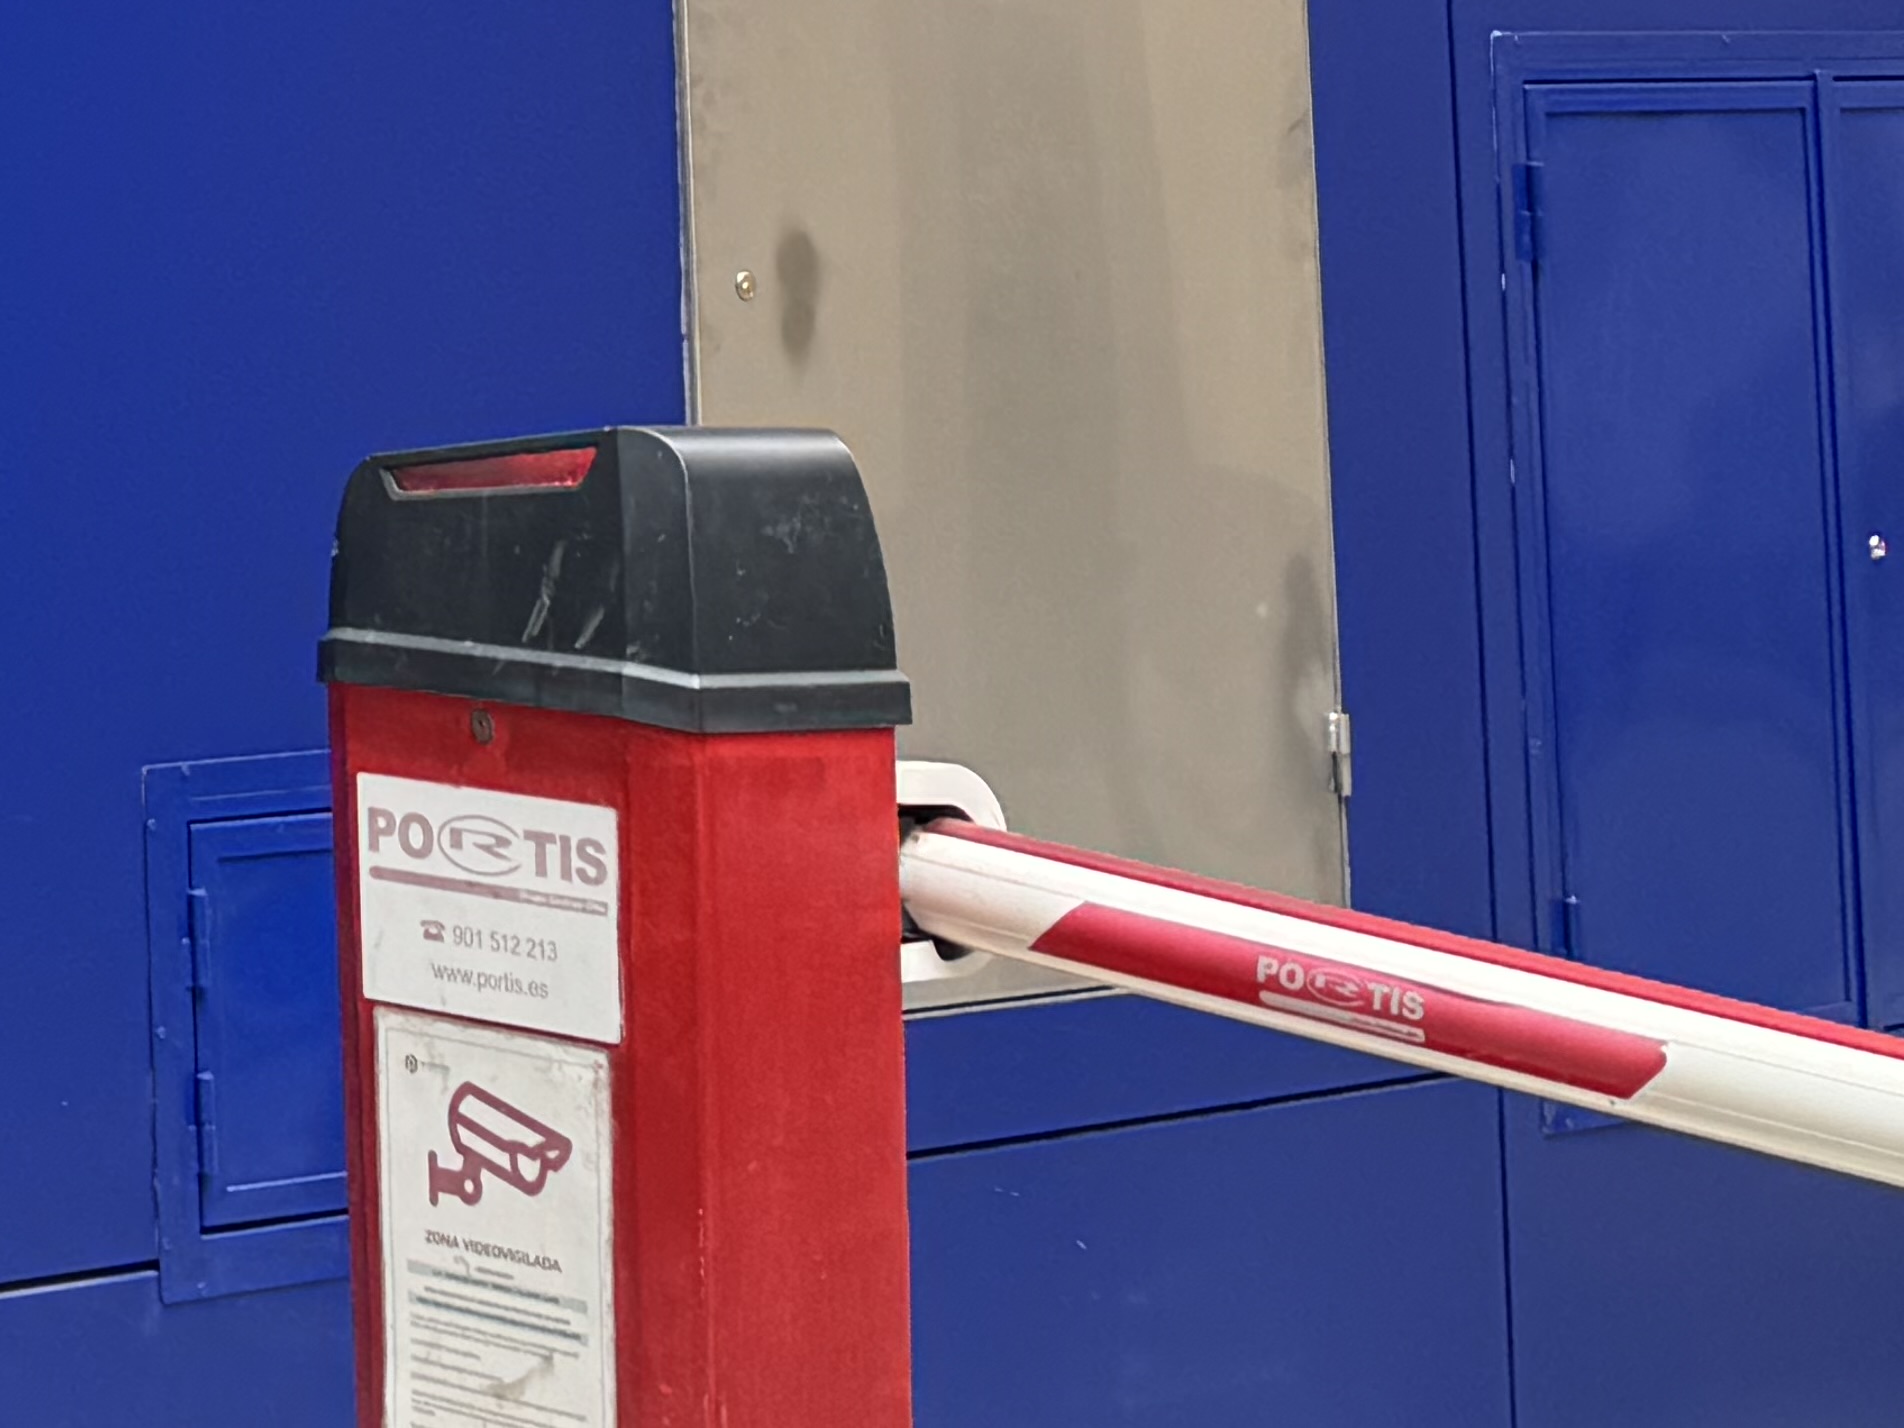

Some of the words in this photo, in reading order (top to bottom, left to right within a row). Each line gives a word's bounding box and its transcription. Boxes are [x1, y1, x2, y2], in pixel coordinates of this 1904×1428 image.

[367, 805, 609, 887] PORTIS
[452, 924, 484, 950] 901
[490, 928, 521, 956] 512
[526, 934, 559, 962] 213
[431, 962, 550, 1001] www.portis.es
[1256, 955, 1425, 1021] PORTIS
